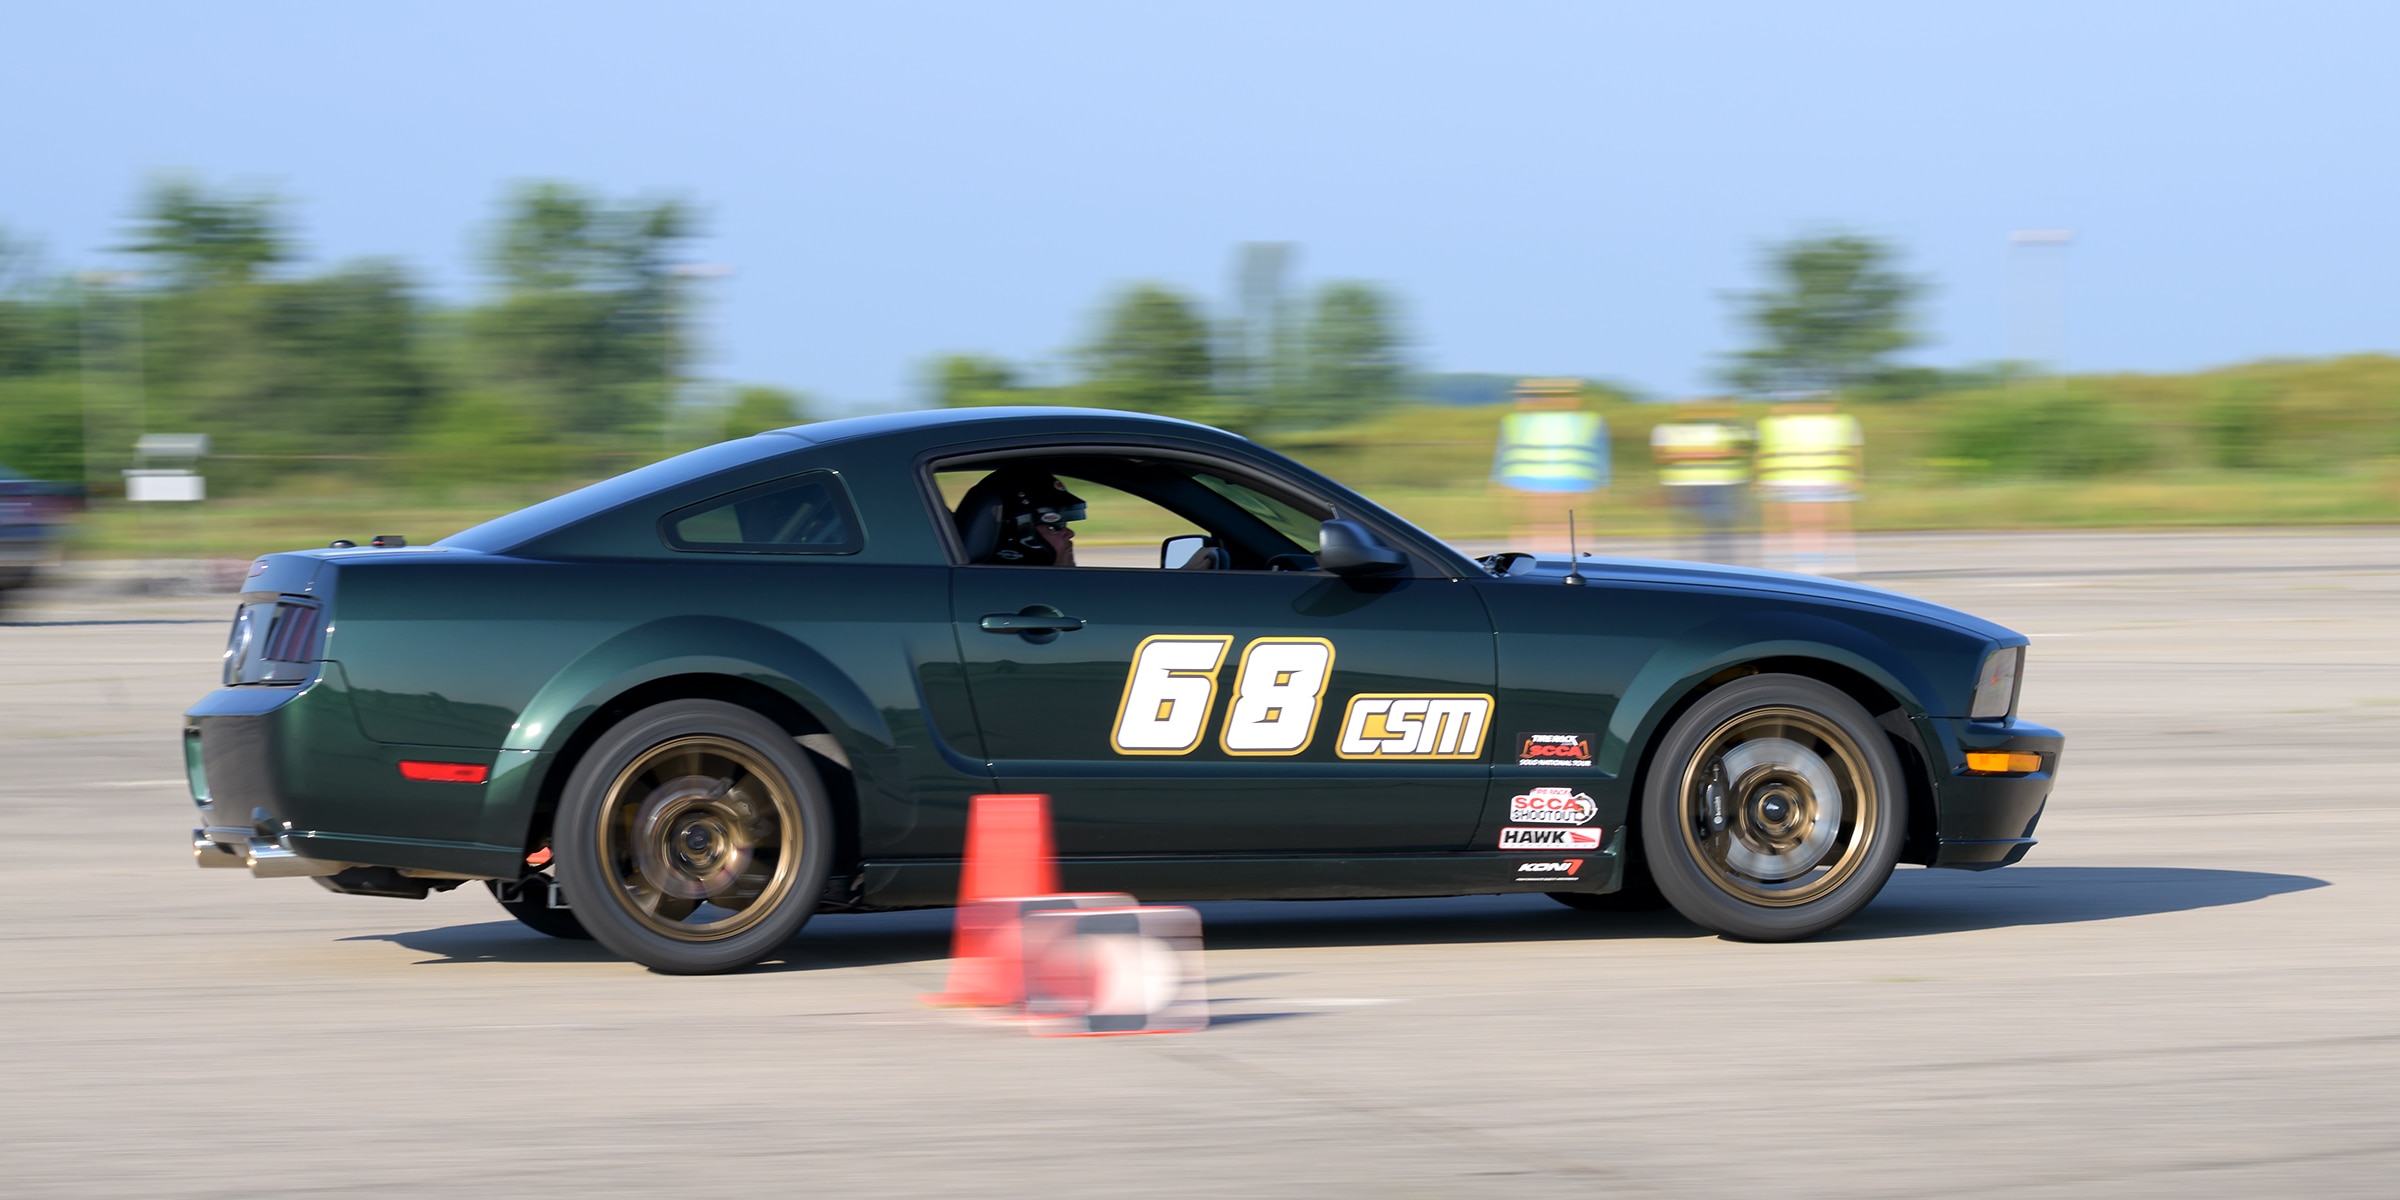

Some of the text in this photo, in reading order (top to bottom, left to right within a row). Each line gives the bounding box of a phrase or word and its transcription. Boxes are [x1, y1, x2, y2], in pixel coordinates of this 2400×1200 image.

[1111, 634, 1495, 759] 68 CSM
[1529, 745, 1583, 757] SCCA
[1515, 797, 1580, 810] SCCA
[1514, 809, 1579, 821] SHOOTOUT
[1504, 830, 1567, 843] HAWK
[1517, 862, 1573, 872] KONI
